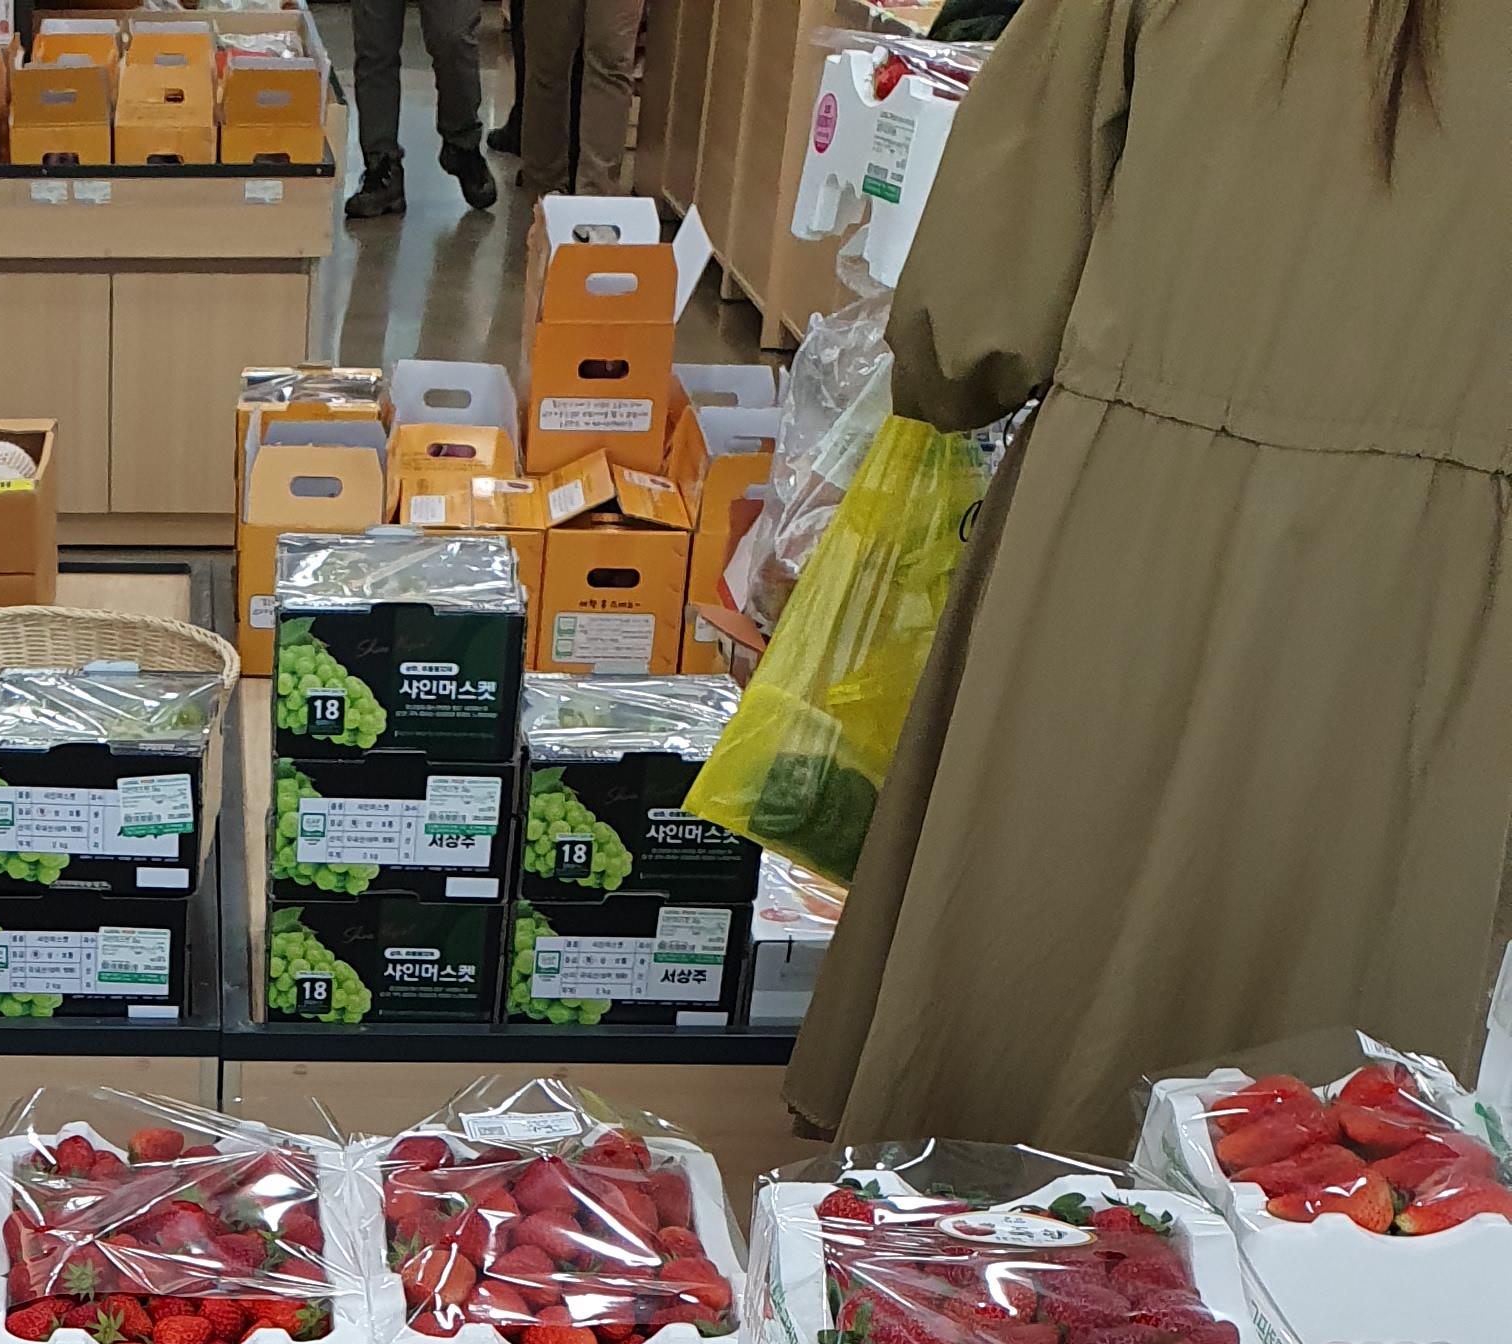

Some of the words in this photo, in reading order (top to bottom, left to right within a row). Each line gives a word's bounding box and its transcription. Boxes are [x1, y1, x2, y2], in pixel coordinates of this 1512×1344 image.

[399, 679, 498, 701] 샤인머스켓
[313, 699, 340, 720] 18
[560, 844, 587, 863] 18
[383, 963, 476, 983] 샤인머스켓
[660, 969, 707, 984] 서상주
[302, 981, 328, 1000] 18
